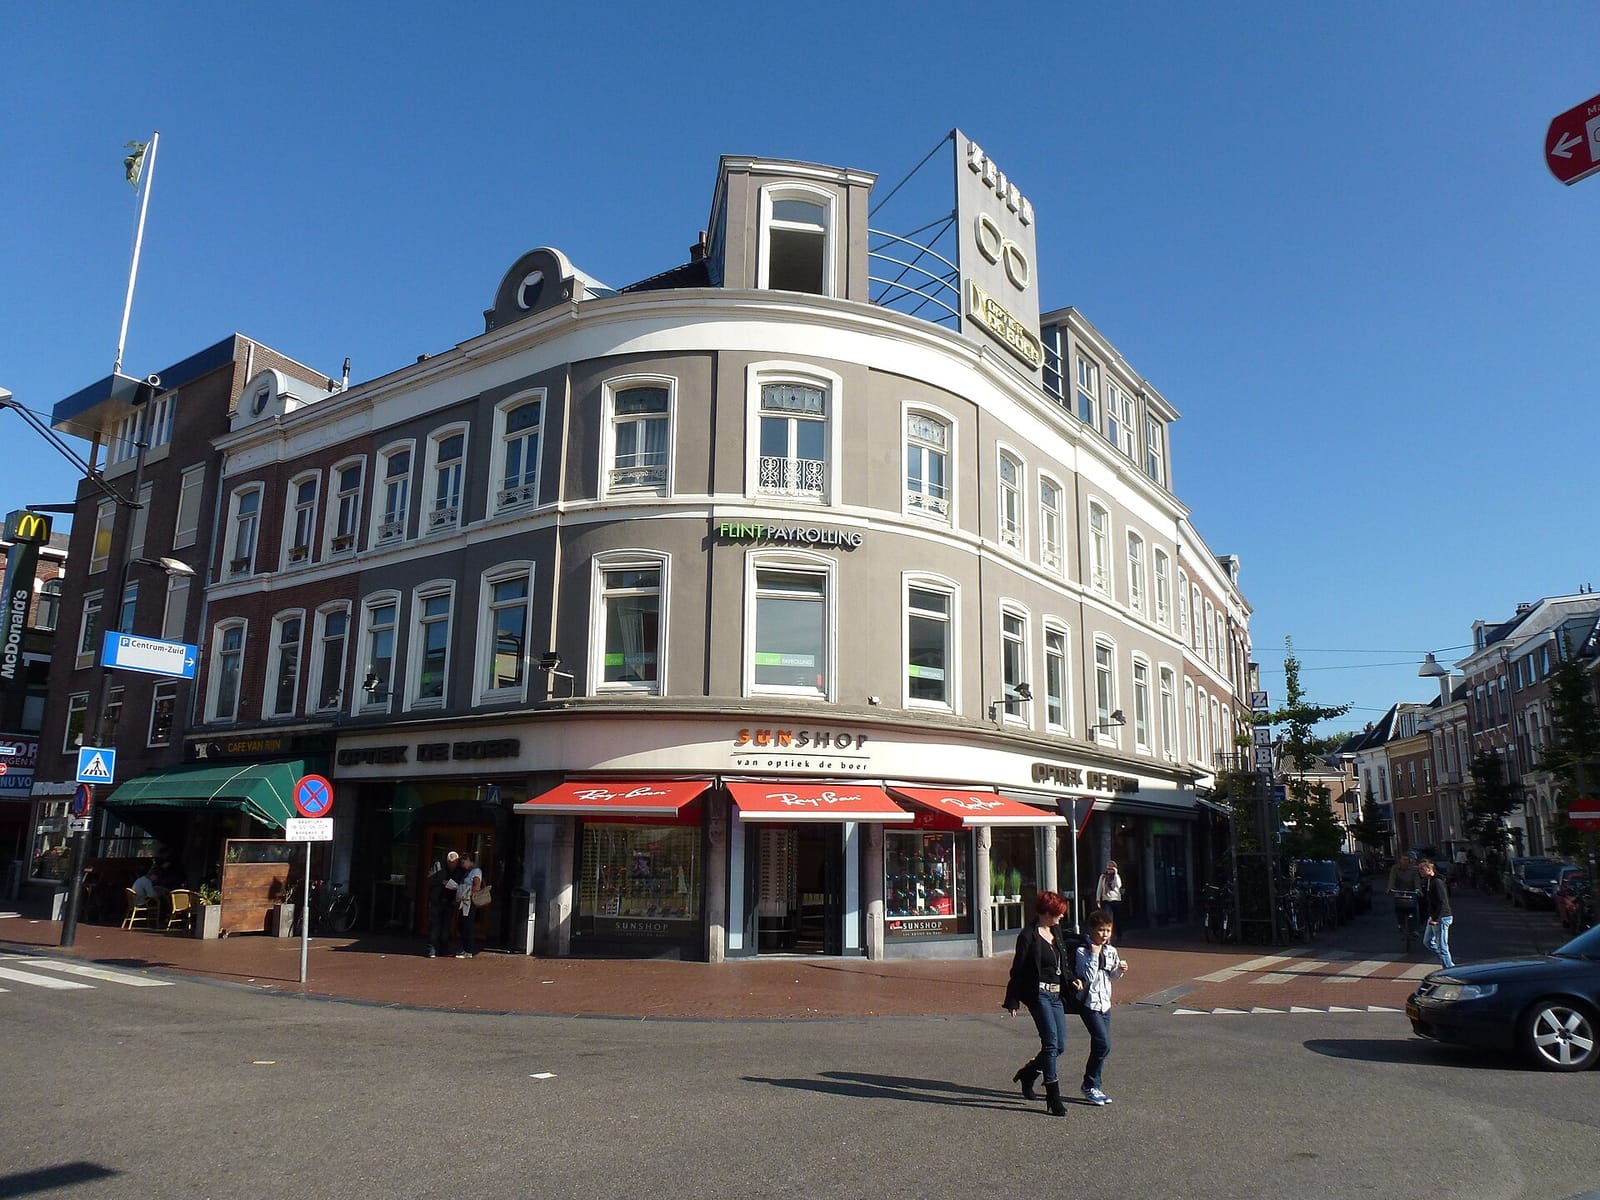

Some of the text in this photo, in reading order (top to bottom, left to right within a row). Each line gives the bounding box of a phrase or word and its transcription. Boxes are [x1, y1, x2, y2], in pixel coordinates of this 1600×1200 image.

[720, 522, 863, 547] FLINT PAYROLLING
[1, 589, 28, 680] McDonald's
[131, 640, 184, 655] Centrum-Zuid
[737, 727, 868, 749] SUNSHOP
[1252, 691, 1272, 774] ZRB
[737, 758, 868, 771] van optiek de boer
[1031, 762, 1083, 788] OPTIEK
[573, 786, 672, 801] Ray-Ban
[765, 791, 861, 807] Ray-Ban
[615, 921, 669, 931] SUNSHOP
[902, 921, 942, 930] SUNSHOP
